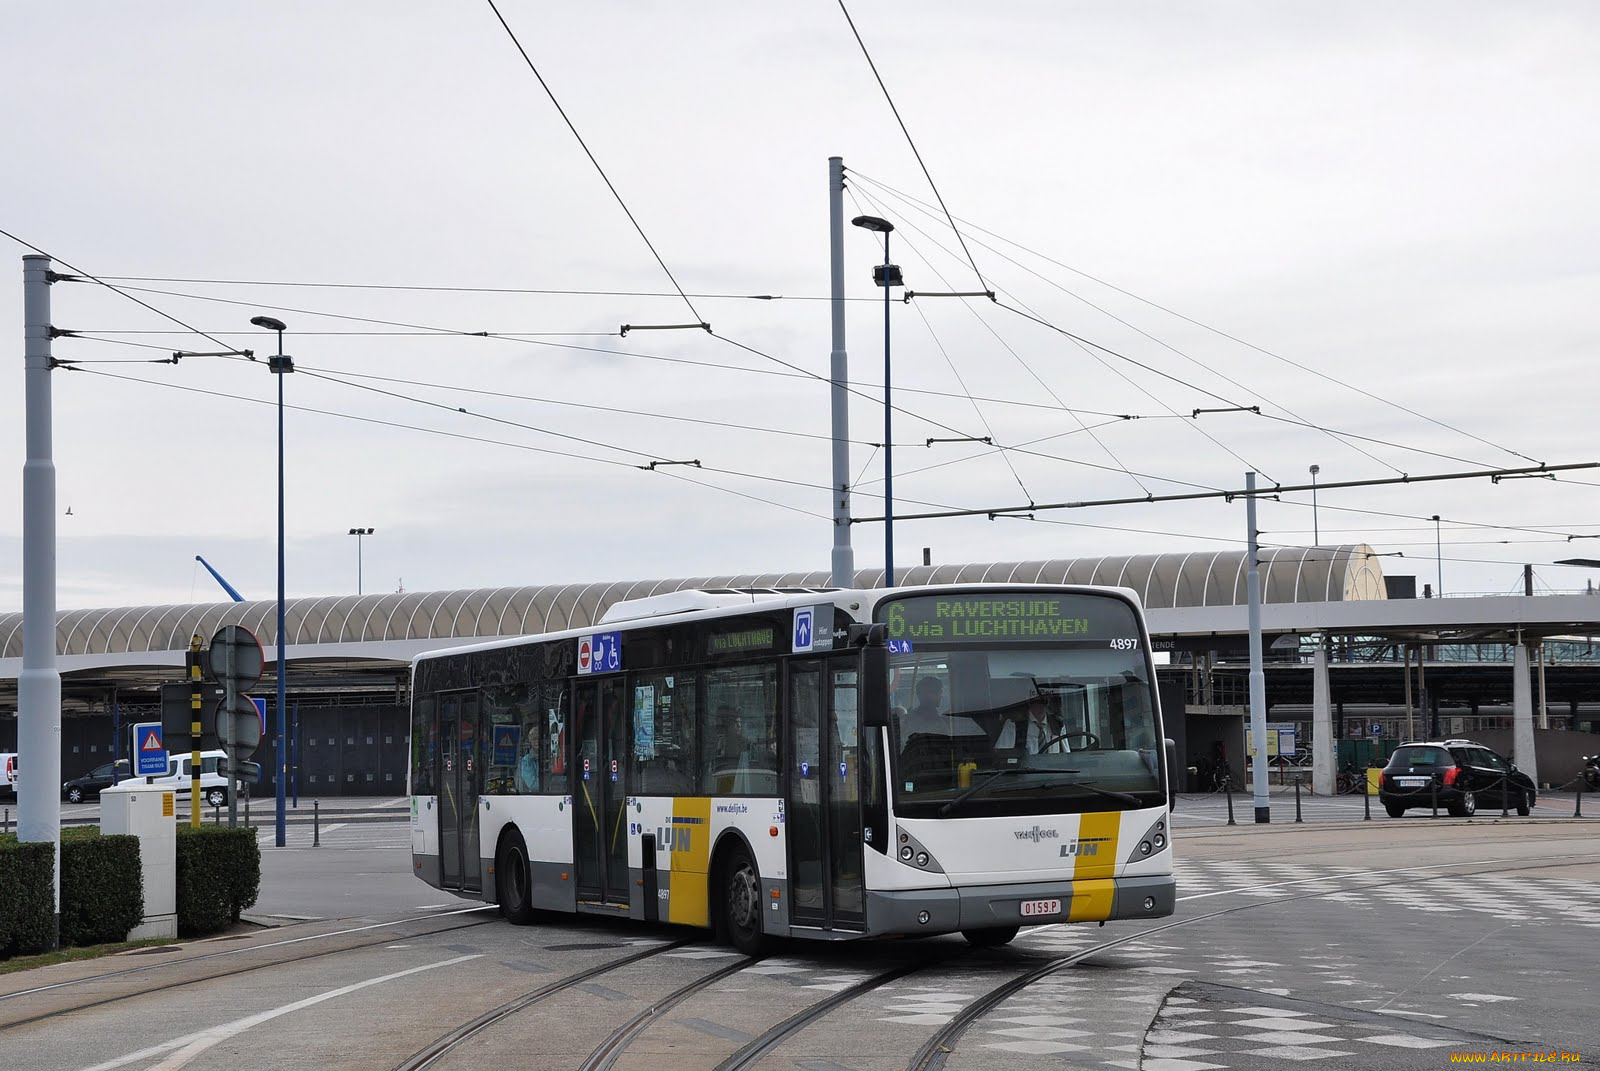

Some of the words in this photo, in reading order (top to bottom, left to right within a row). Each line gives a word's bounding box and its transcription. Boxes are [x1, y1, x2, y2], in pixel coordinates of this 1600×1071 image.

[936, 601, 1060, 618] RAVERSIJDE
[888, 602, 905, 637] 6
[909, 621, 943, 636] via
[952, 618, 1088, 636] LUCHTHAVEN
[1109, 638, 1138, 650] 4897
[716, 804, 748, 815] www.delijn.be
[657, 827, 690, 851] LIJN
[1060, 843, 1098, 857] LIJN
[657, 889, 669, 899] 4897
